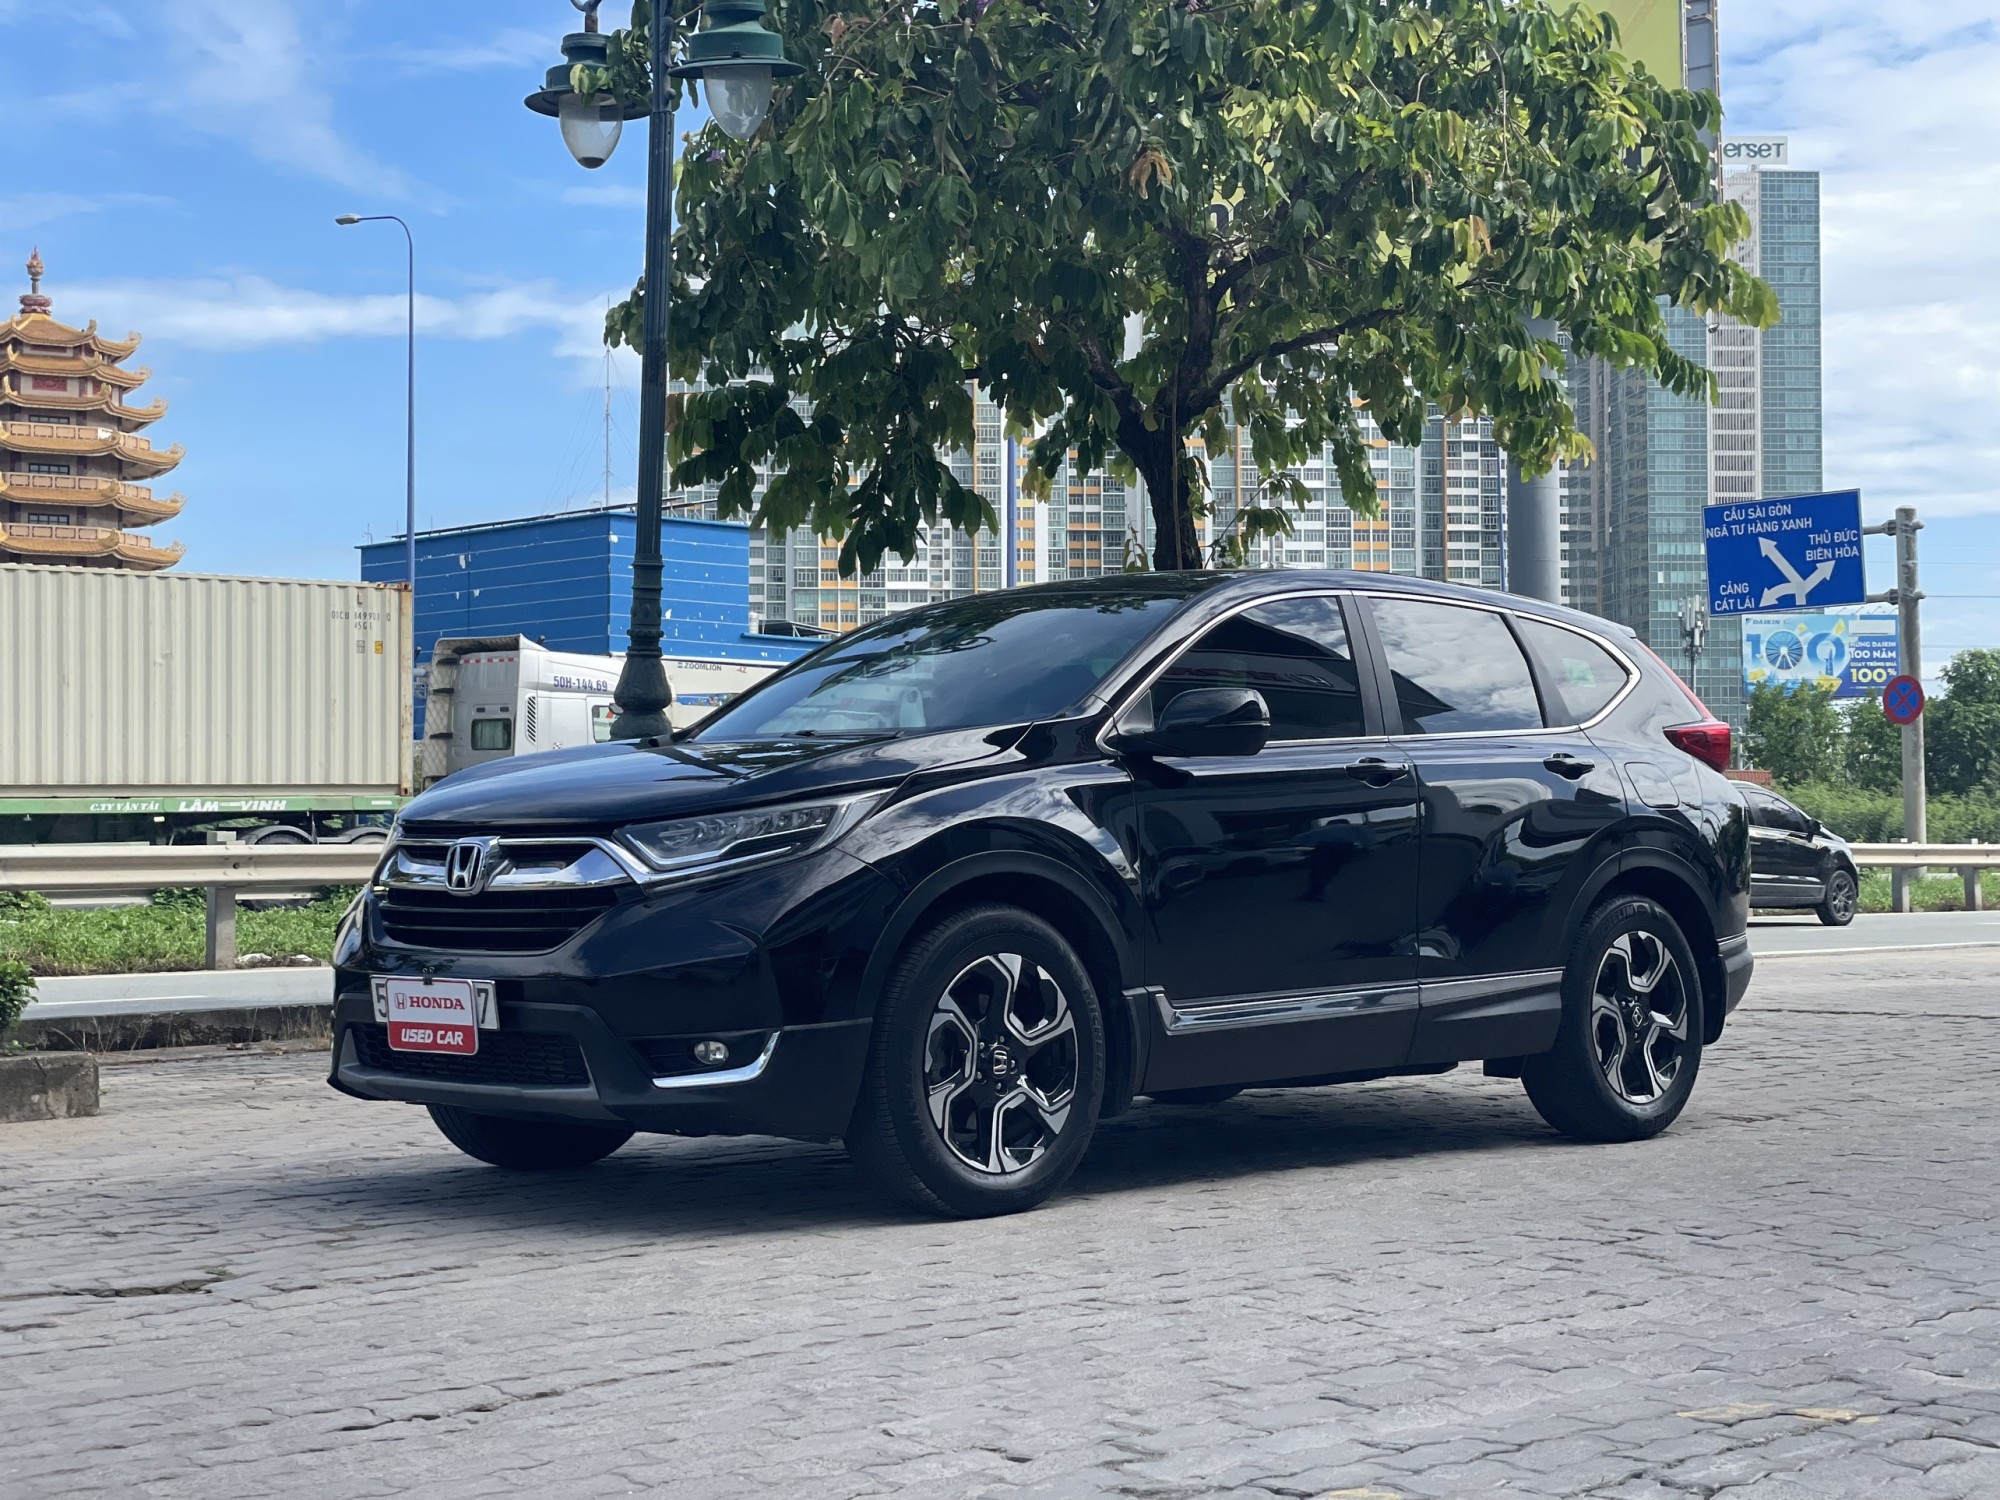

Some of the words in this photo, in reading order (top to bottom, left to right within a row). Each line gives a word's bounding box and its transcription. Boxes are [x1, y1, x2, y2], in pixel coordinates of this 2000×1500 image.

[1747, 505, 1766, 519] SÀI
[1768, 503, 1792, 517] GÒN
[1706, 524, 1729, 539] NGÃ
[1730, 523, 1746, 536] TƯ
[1747, 520, 1779, 535] HÀNG
[1781, 517, 1812, 531] XANH
[1808, 529, 1831, 545] THỦ
[1834, 527, 1859, 543] ĐỨC
[1805, 546, 1832, 562] BIÊN
[1835, 543, 1860, 558] HÒA
[1720, 580, 1750, 596] CẢNG
[1714, 597, 1736, 611] CÁT
[1737, 595, 1755, 610] LÁI
[1872, 647, 1897, 659] NĂM
[684, 662, 722, 671] ZOOMLION
[1850, 667, 1898, 683] 100%
[553, 675, 608, 692] 50H-144.69
[179, 799, 219, 812] LÂM
[240, 800, 287, 811] VINH
[408, 996, 466, 1011] HONDA
[401, 1028, 434, 1043] USED
[436, 1030, 464, 1046] CAR
